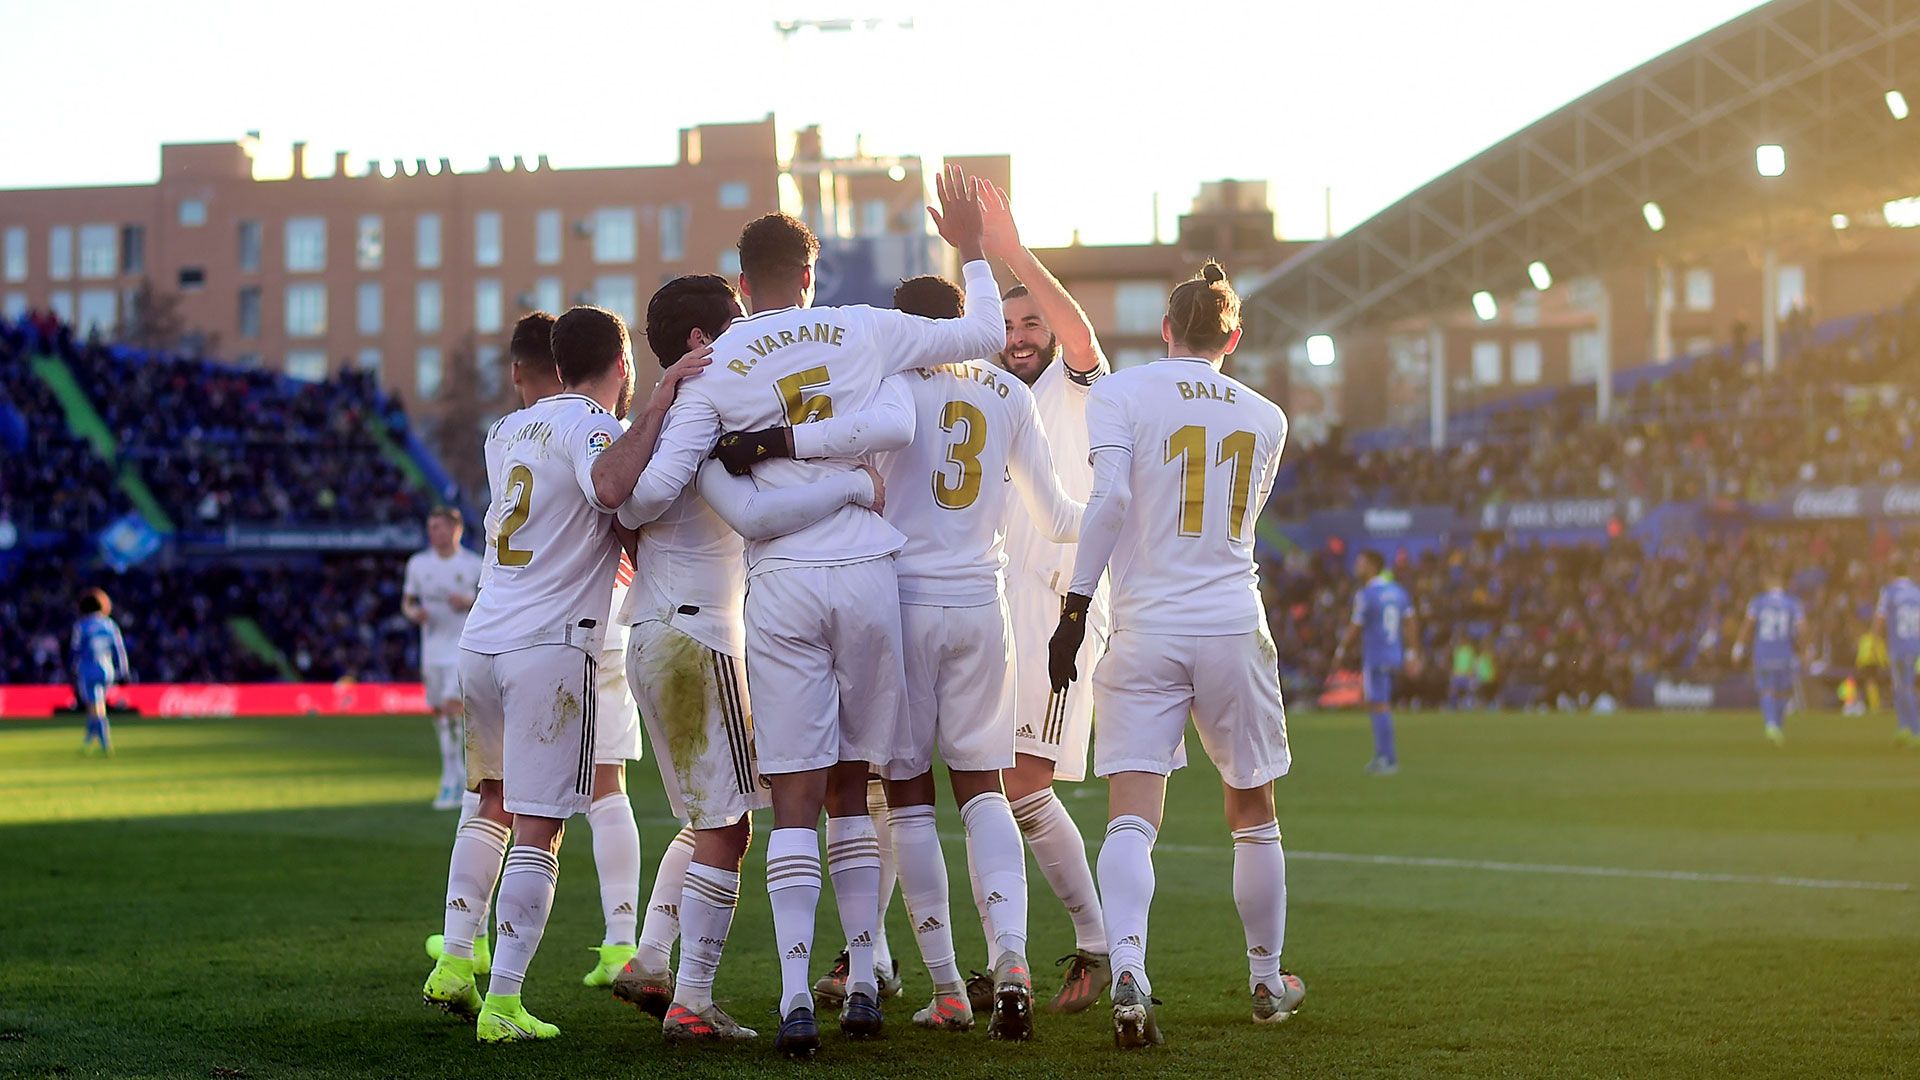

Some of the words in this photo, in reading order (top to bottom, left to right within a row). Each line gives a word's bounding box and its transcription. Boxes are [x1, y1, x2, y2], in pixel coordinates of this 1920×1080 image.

[772, 365, 834, 426] 5
[1176, 382, 1237, 404] BALE
[931, 400, 988, 511] 3
[1164, 425, 1257, 544] 11
[494, 464, 534, 569] 2
